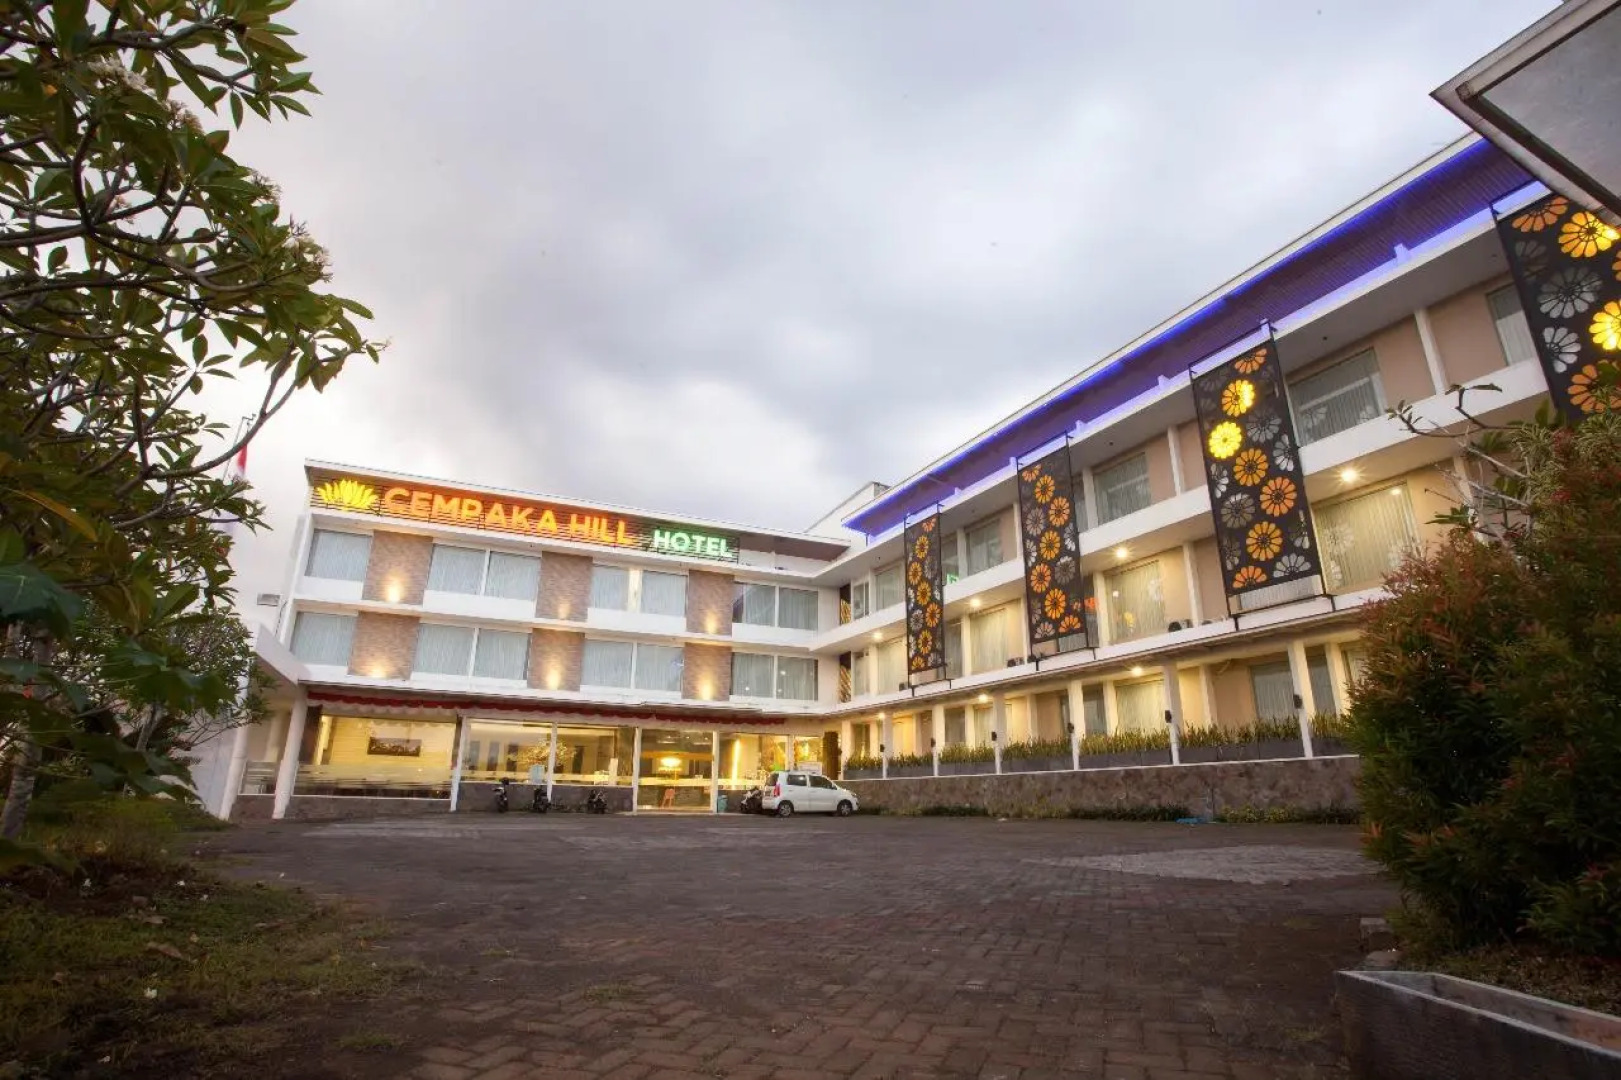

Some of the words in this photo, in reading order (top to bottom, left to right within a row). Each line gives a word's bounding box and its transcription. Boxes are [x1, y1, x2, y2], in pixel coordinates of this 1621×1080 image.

[384, 487, 558, 533] CEMPAKA
[570, 513, 632, 545] HILL
[654, 529, 733, 558] HOTEL
